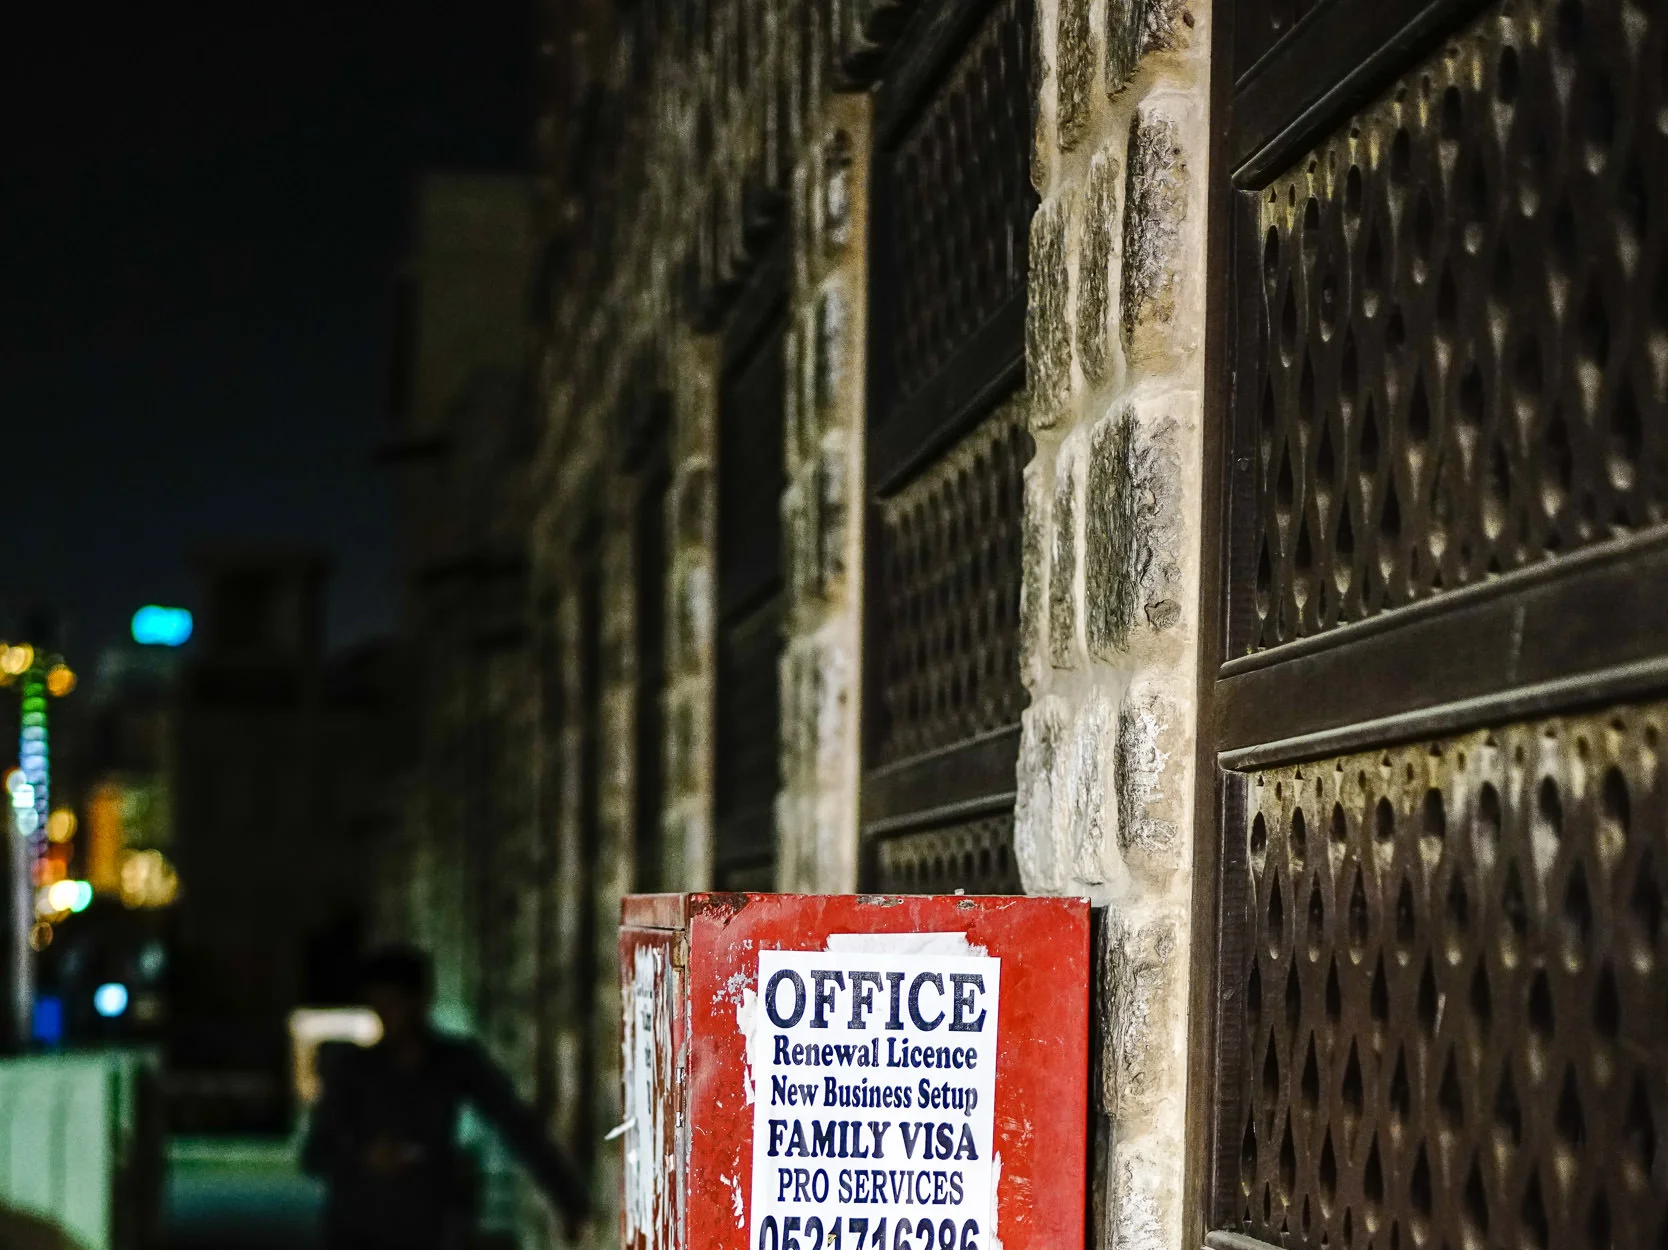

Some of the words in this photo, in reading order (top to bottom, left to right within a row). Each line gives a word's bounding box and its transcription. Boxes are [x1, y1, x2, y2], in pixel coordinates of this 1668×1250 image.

[764, 968, 988, 1033] OFFICE
[772, 1034, 880, 1068] Renewal
[886, 1036, 978, 1070] Licence
[770, 1074, 819, 1107] New
[822, 1076, 913, 1109] Business
[917, 1077, 978, 1117] Setup
[766, 1118, 892, 1160] FAMILY
[898, 1121, 979, 1161] VISA
[777, 1167, 830, 1204] PRO
[838, 1168, 964, 1206] SERVICES
